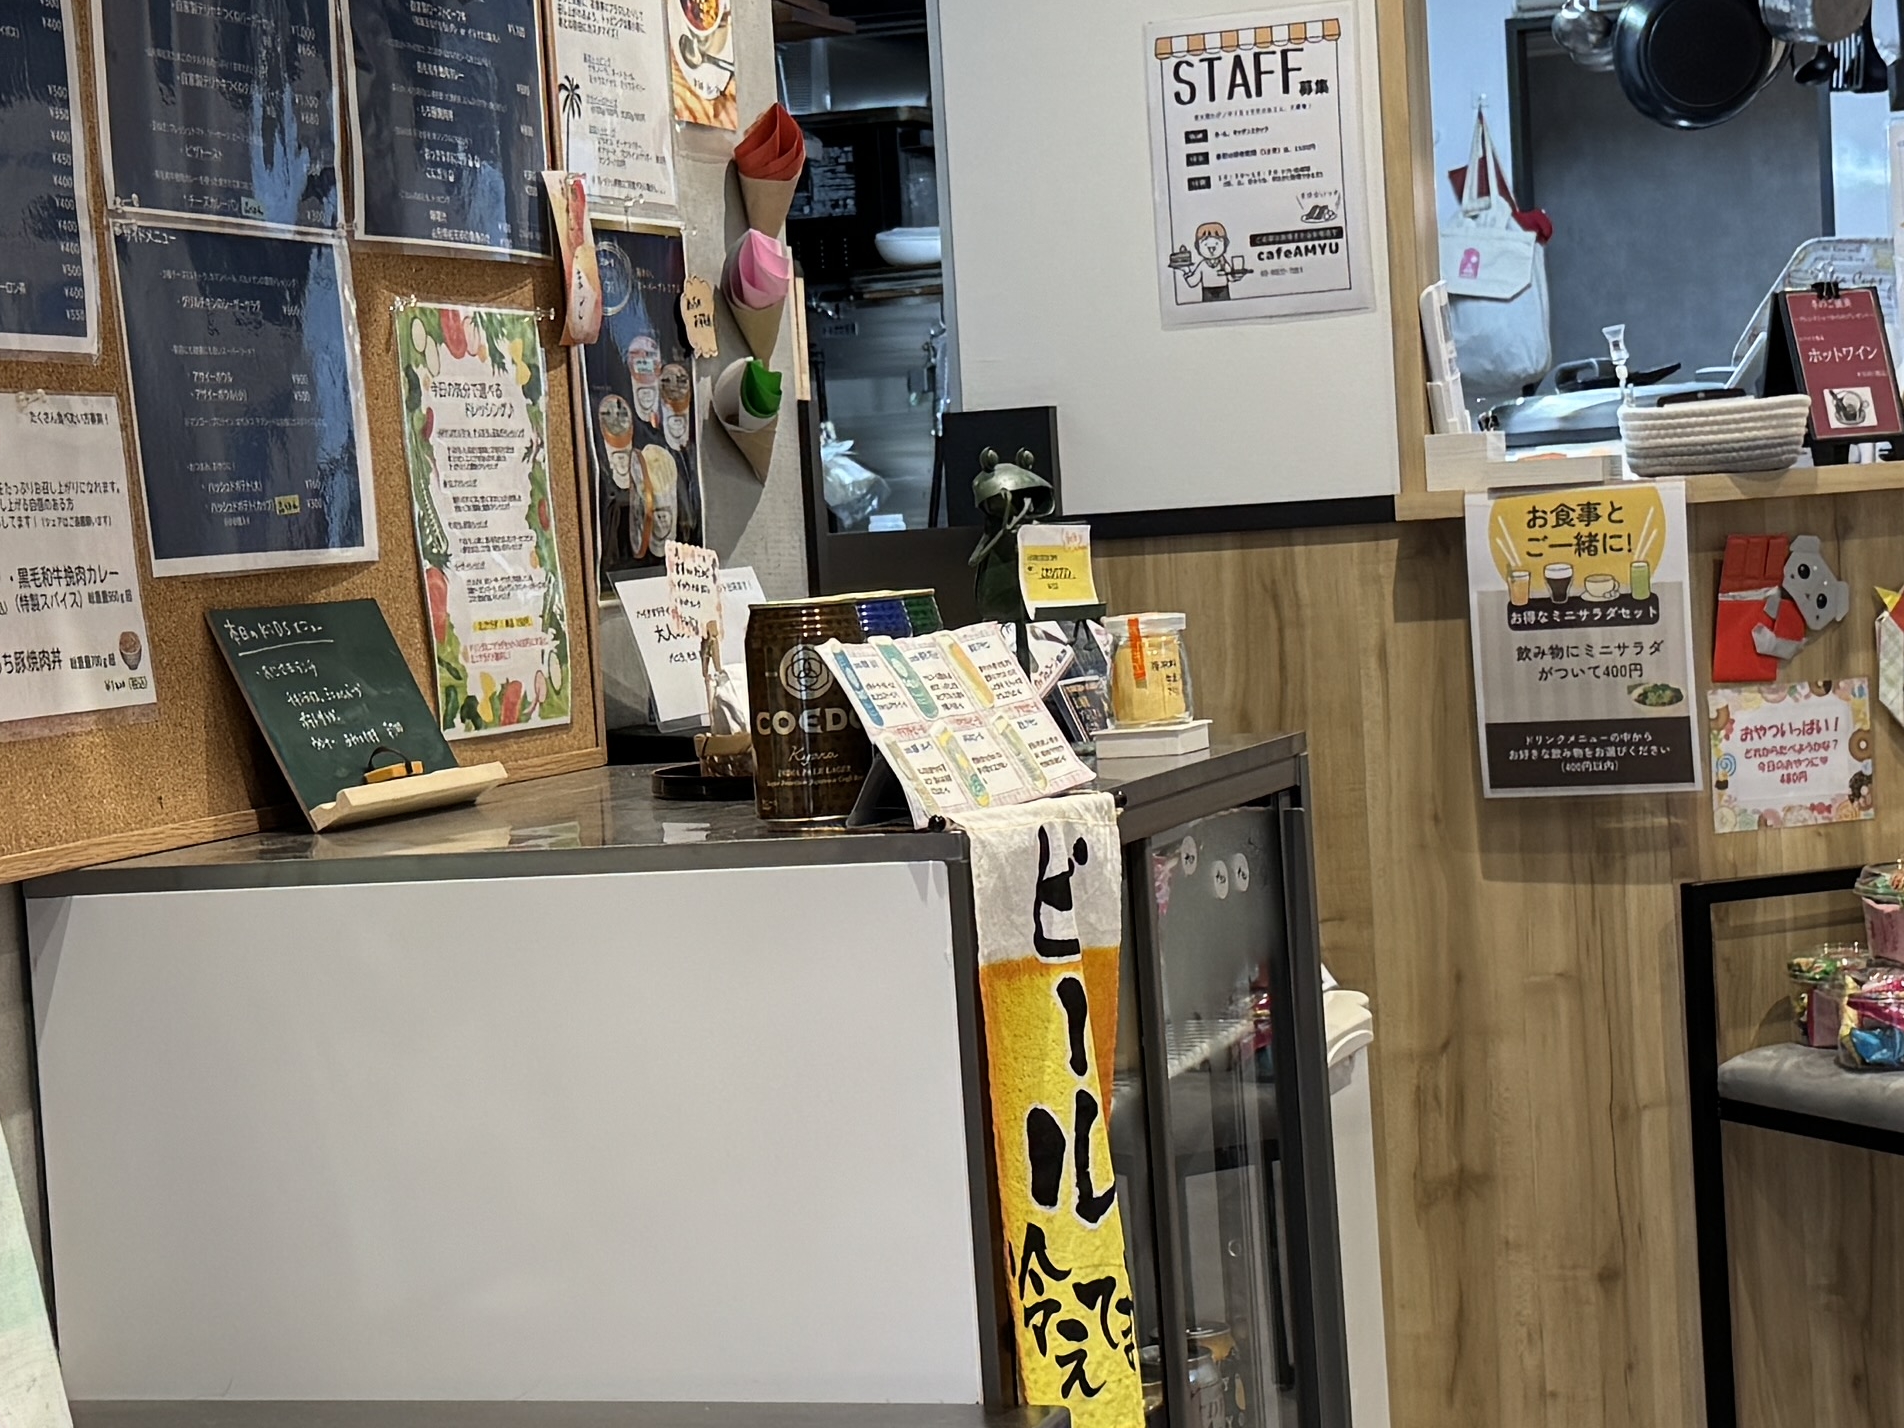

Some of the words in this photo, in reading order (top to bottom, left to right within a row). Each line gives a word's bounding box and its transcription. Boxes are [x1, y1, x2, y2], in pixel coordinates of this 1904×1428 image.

[1173, 48, 1304, 106] STAFF
[1257, 242, 1339, 261] cafeAMYU
[1808, 346, 1877, 363] ホットワイン
[1526, 502, 1624, 529] お食事と
[1525, 533, 1633, 557] ご一緒に!
[1510, 606, 1658, 625] お得なミニサラダセット
[1516, 639, 1663, 662] 飲み物にミニサラダ
[1538, 663, 1643, 681] がついて400円
[1525, 731, 1652, 746] ドリンクメニューの中から
[1740, 717, 1839, 742] おやついっぱい！
[1033, 824, 1117, 1224] ビール
